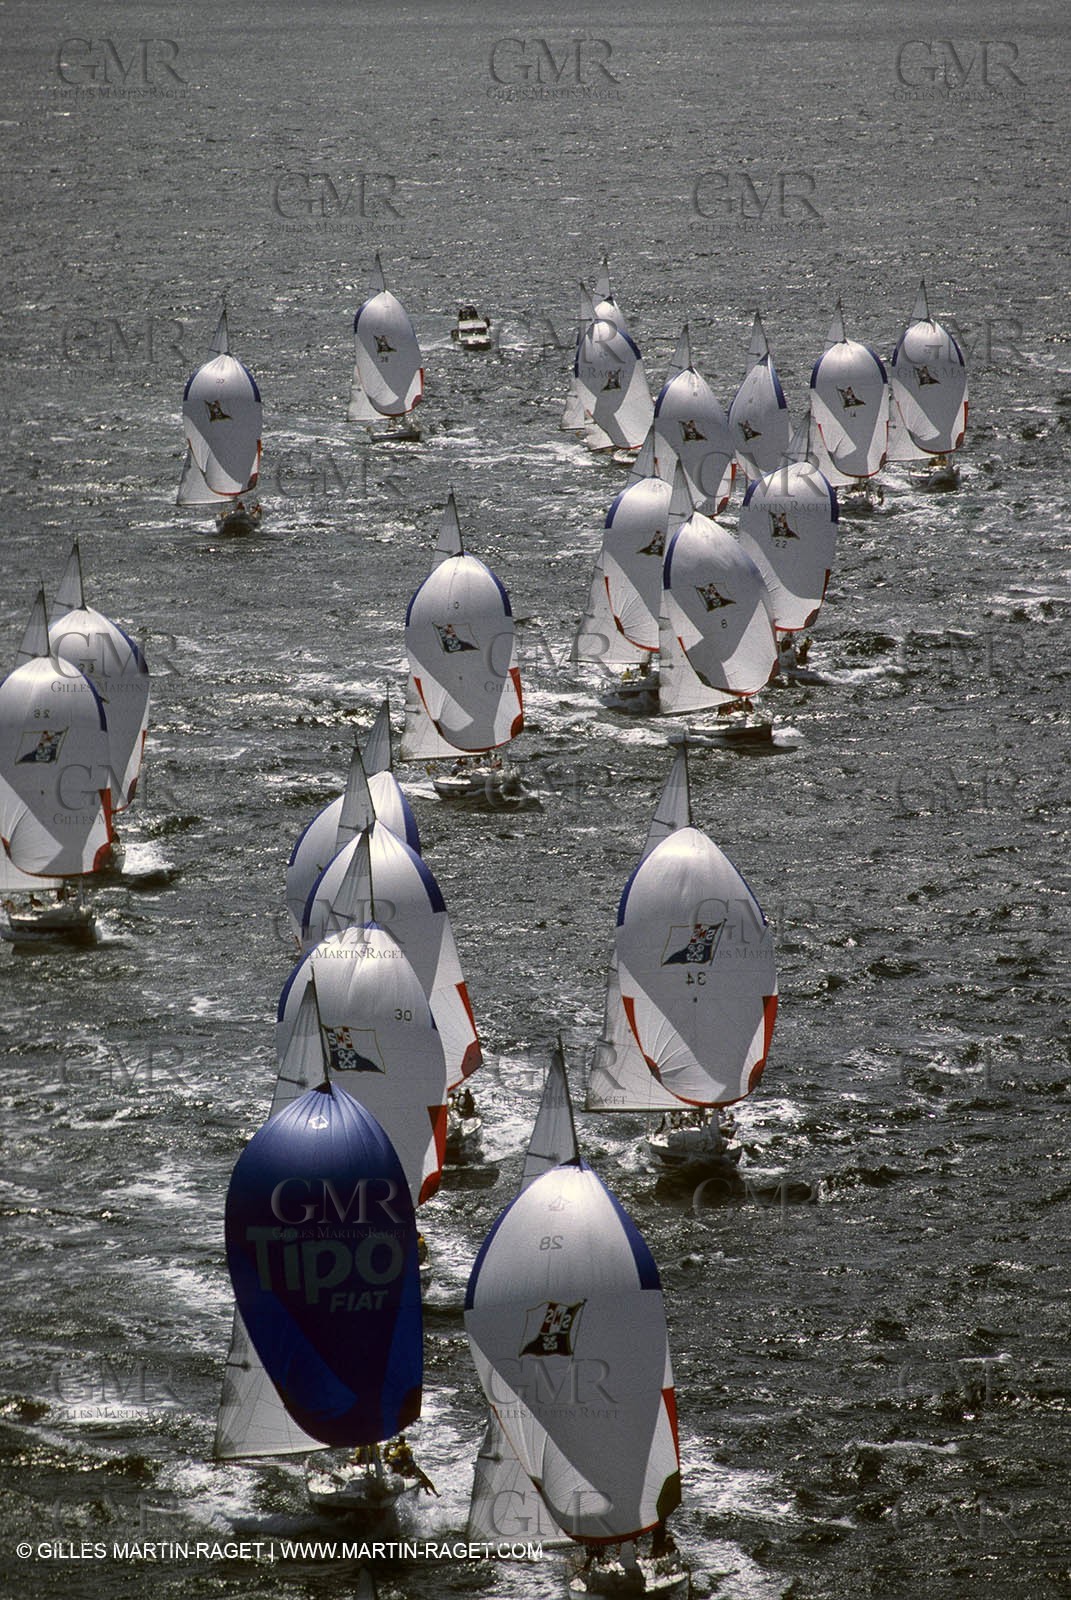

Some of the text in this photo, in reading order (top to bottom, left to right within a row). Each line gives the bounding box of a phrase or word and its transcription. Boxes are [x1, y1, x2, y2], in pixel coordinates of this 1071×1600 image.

[394, 1008, 413, 1022] 30
[246, 1226, 404, 1306] Tipo
[329, 1289, 390, 1312] FIAT
